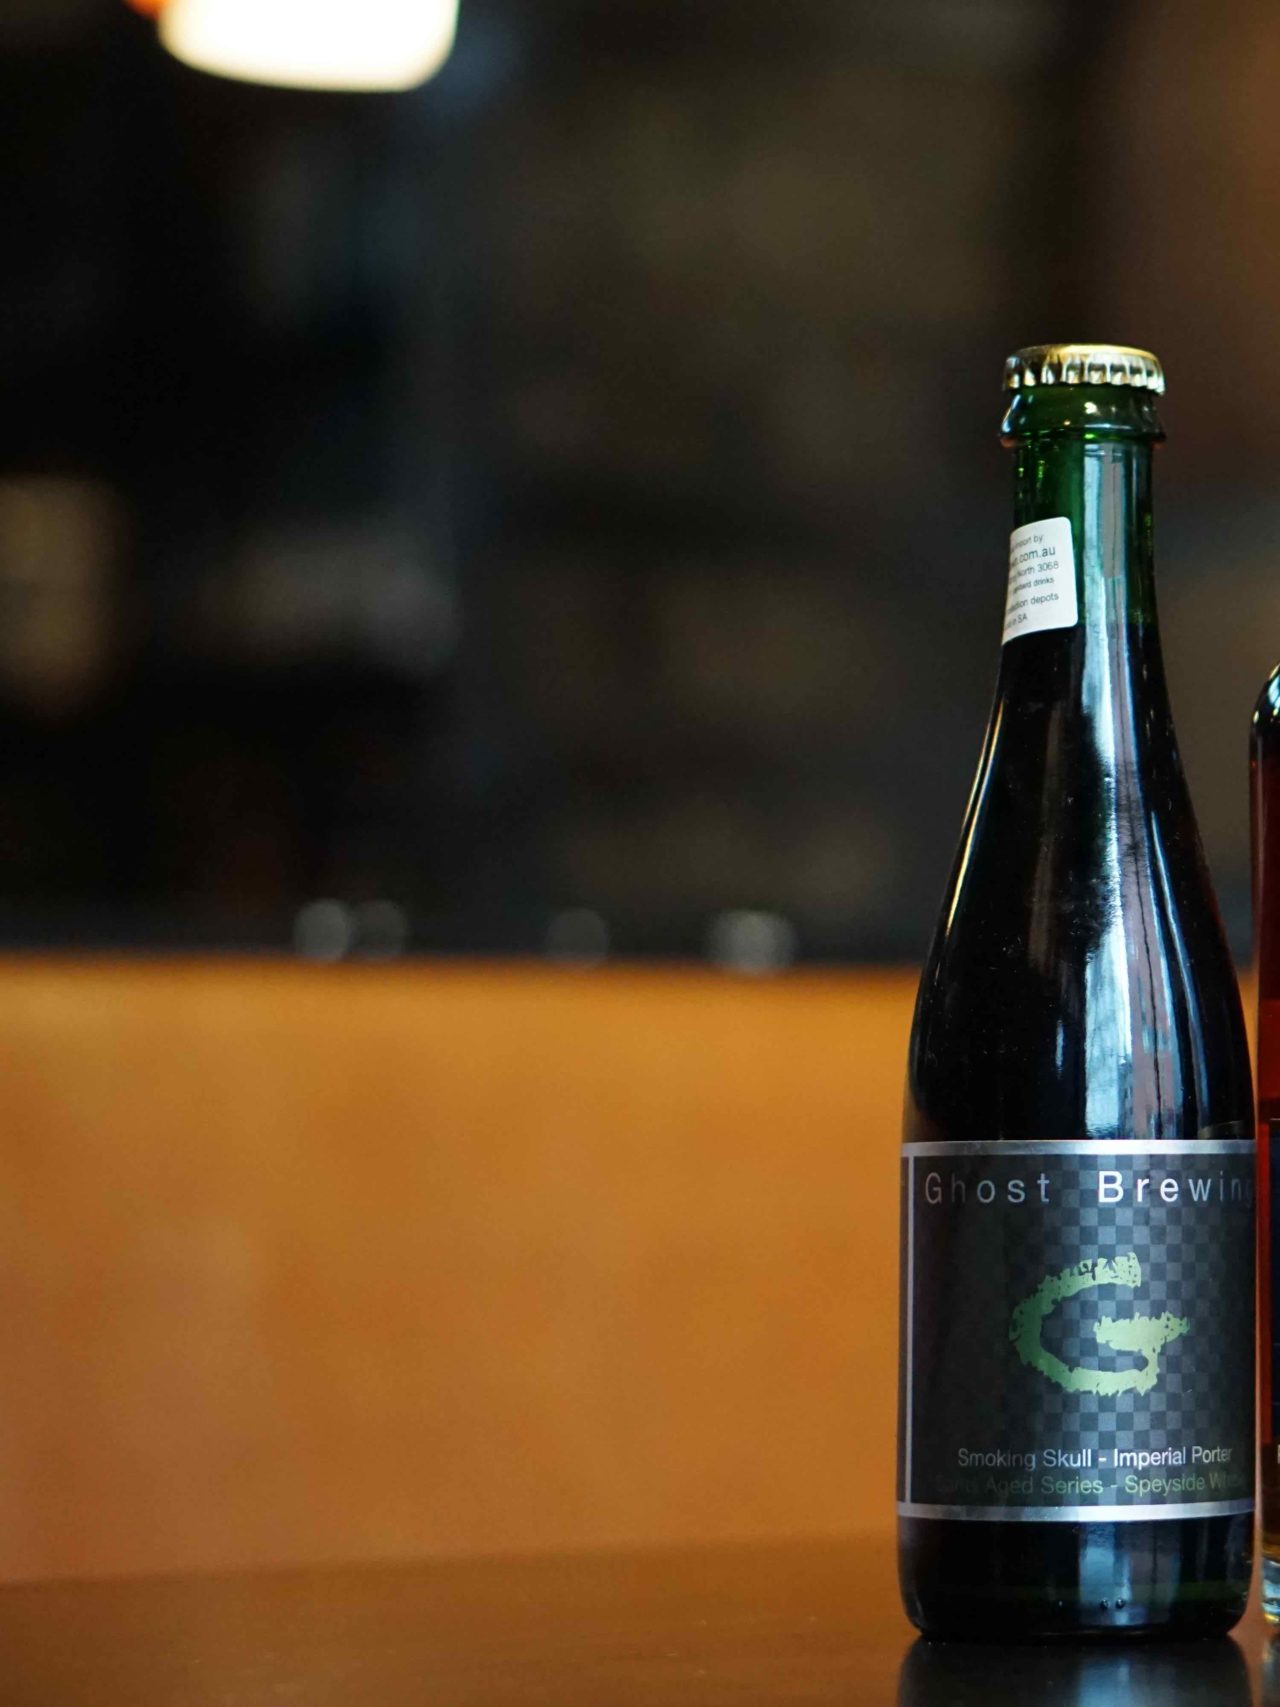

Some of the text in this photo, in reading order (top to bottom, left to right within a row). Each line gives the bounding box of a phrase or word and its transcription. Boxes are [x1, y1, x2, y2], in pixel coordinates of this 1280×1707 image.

[1037, 560, 1059, 573] 3068
[1030, 592, 1059, 605] depots
[924, 1171, 1051, 1204] Ghost
[1009, 1252, 1191, 1397] G
[958, 1447, 1036, 1471] Smoking
[1042, 1448, 1092, 1468] Skull
[1113, 1446, 1186, 1471] Imperial
[1191, 1445, 1233, 1464] Porter
[985, 1474, 1034, 1500] Aged
[1041, 1475, 1103, 1495] Series
[1125, 1472, 1206, 1497] Speyside
